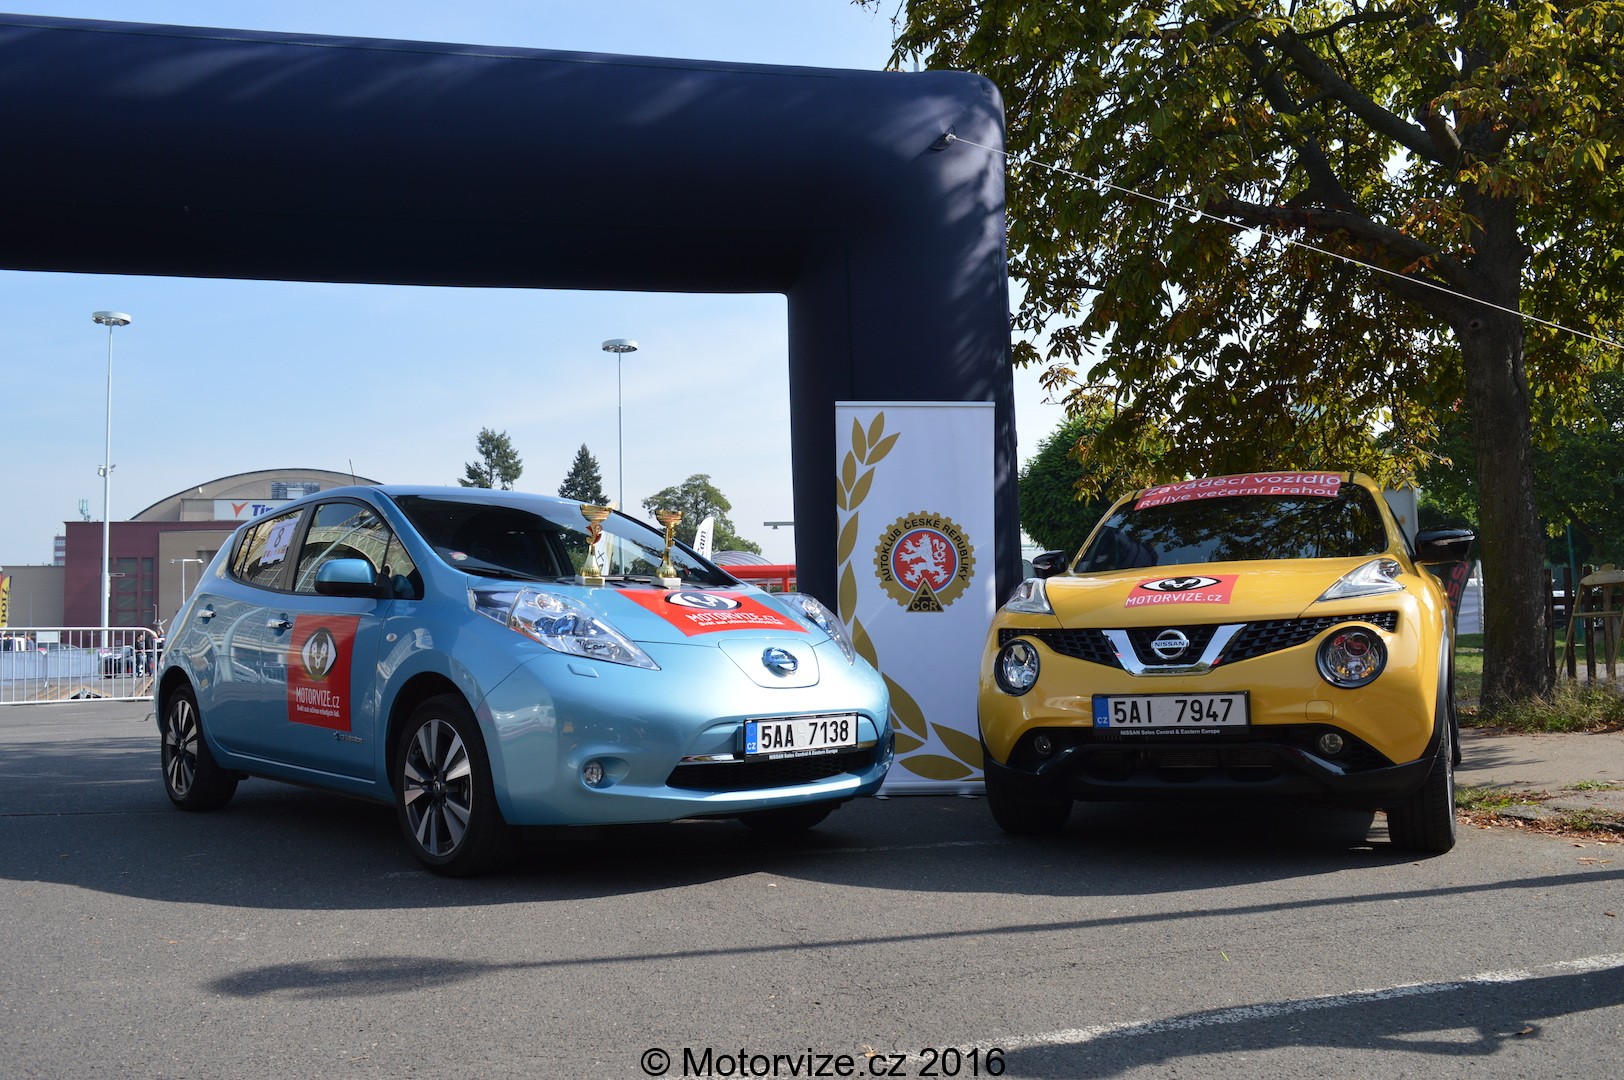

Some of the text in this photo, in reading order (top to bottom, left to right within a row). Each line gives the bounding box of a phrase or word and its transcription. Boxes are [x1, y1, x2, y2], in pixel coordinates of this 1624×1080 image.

[1254, 474, 1341, 485] vozidlo
[1139, 486, 1339, 509] Rallye večerní Prahou
[274, 527, 285, 547] 8
[880, 518, 969, 582] AUTOKLUB ČESKÉ REPUBLIKY
[1125, 592, 1223, 606] MOTORVIZE.cz
[1154, 640, 1185, 648] NISSAN
[1097, 716, 1108, 724] CZ
[1113, 699, 1233, 724] 5AI 7947
[761, 720, 849, 749] 5AA 7138
[746, 742, 756, 750] CZ
